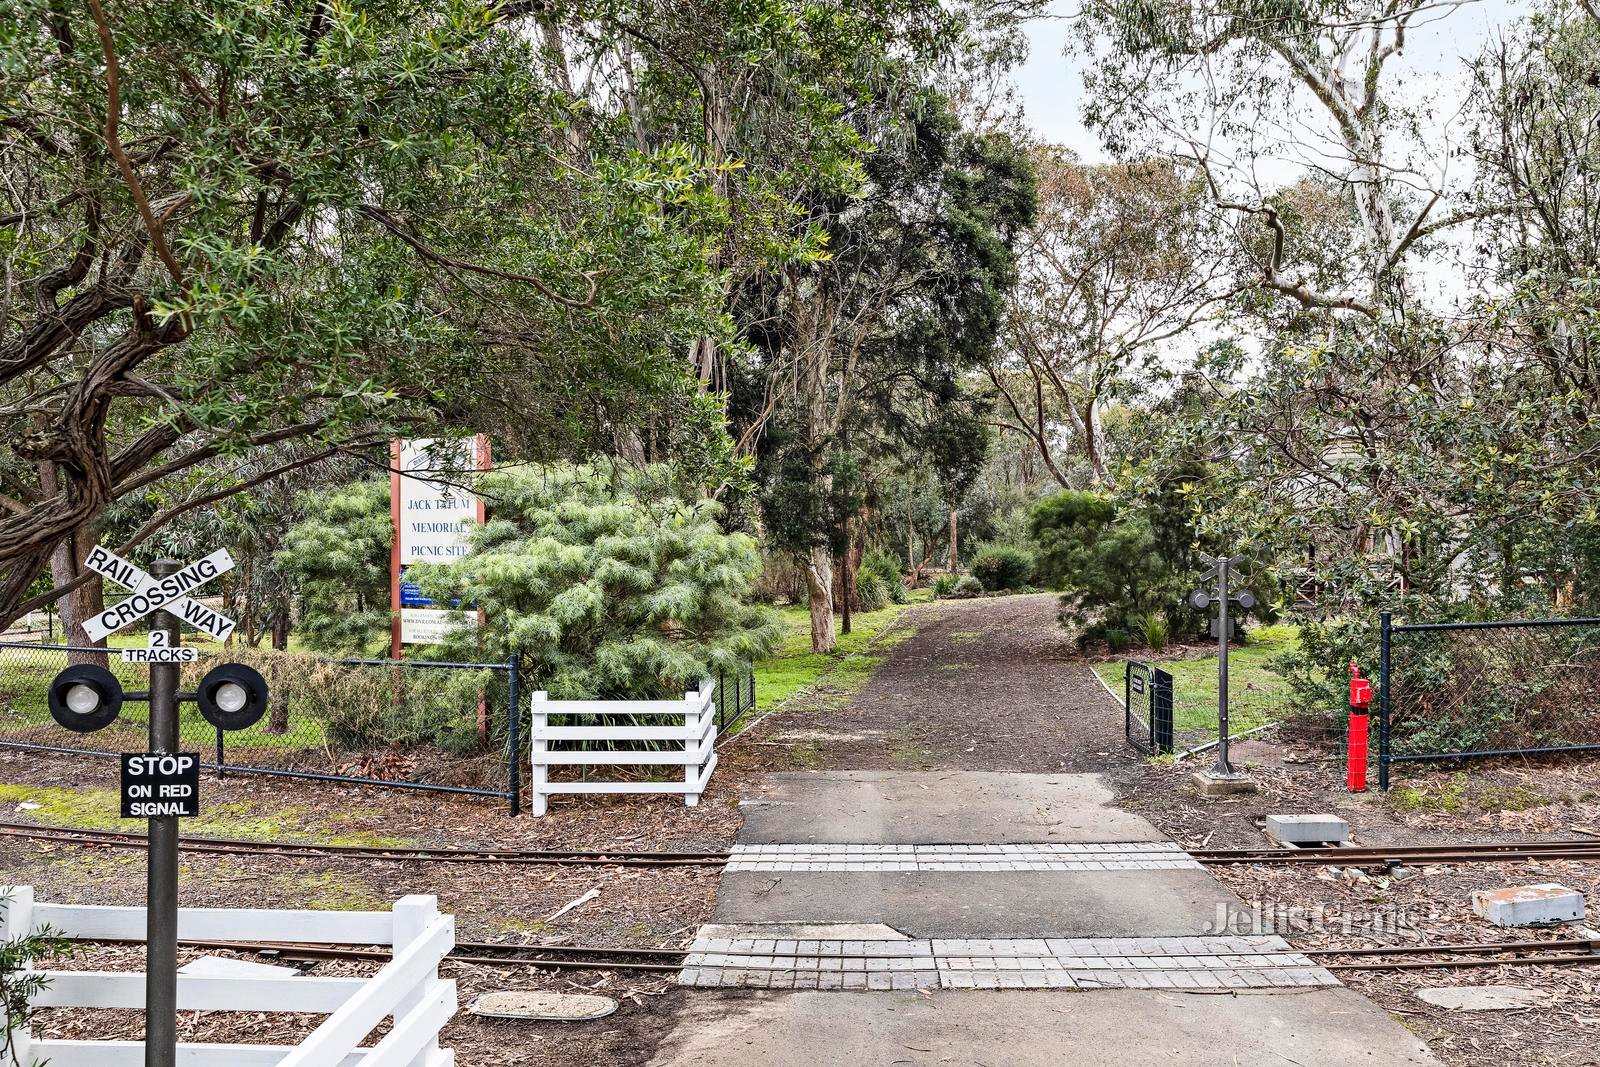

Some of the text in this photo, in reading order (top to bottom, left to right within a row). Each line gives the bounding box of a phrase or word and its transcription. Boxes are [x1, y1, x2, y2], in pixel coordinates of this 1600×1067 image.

[407, 499, 431, 510] JACK
[412, 522, 466, 533] MEMORIAL
[411, 545, 444, 556] PICNIC
[87, 549, 232, 637] RAIL WAY
[101, 560, 218, 630] CROSSING
[152, 632, 164, 647] 2
[127, 649, 193, 662] TRACKS
[128, 756, 193, 776] STOP
[128, 784, 192, 798] ON RED
[130, 802, 189, 816] SIGNAL
